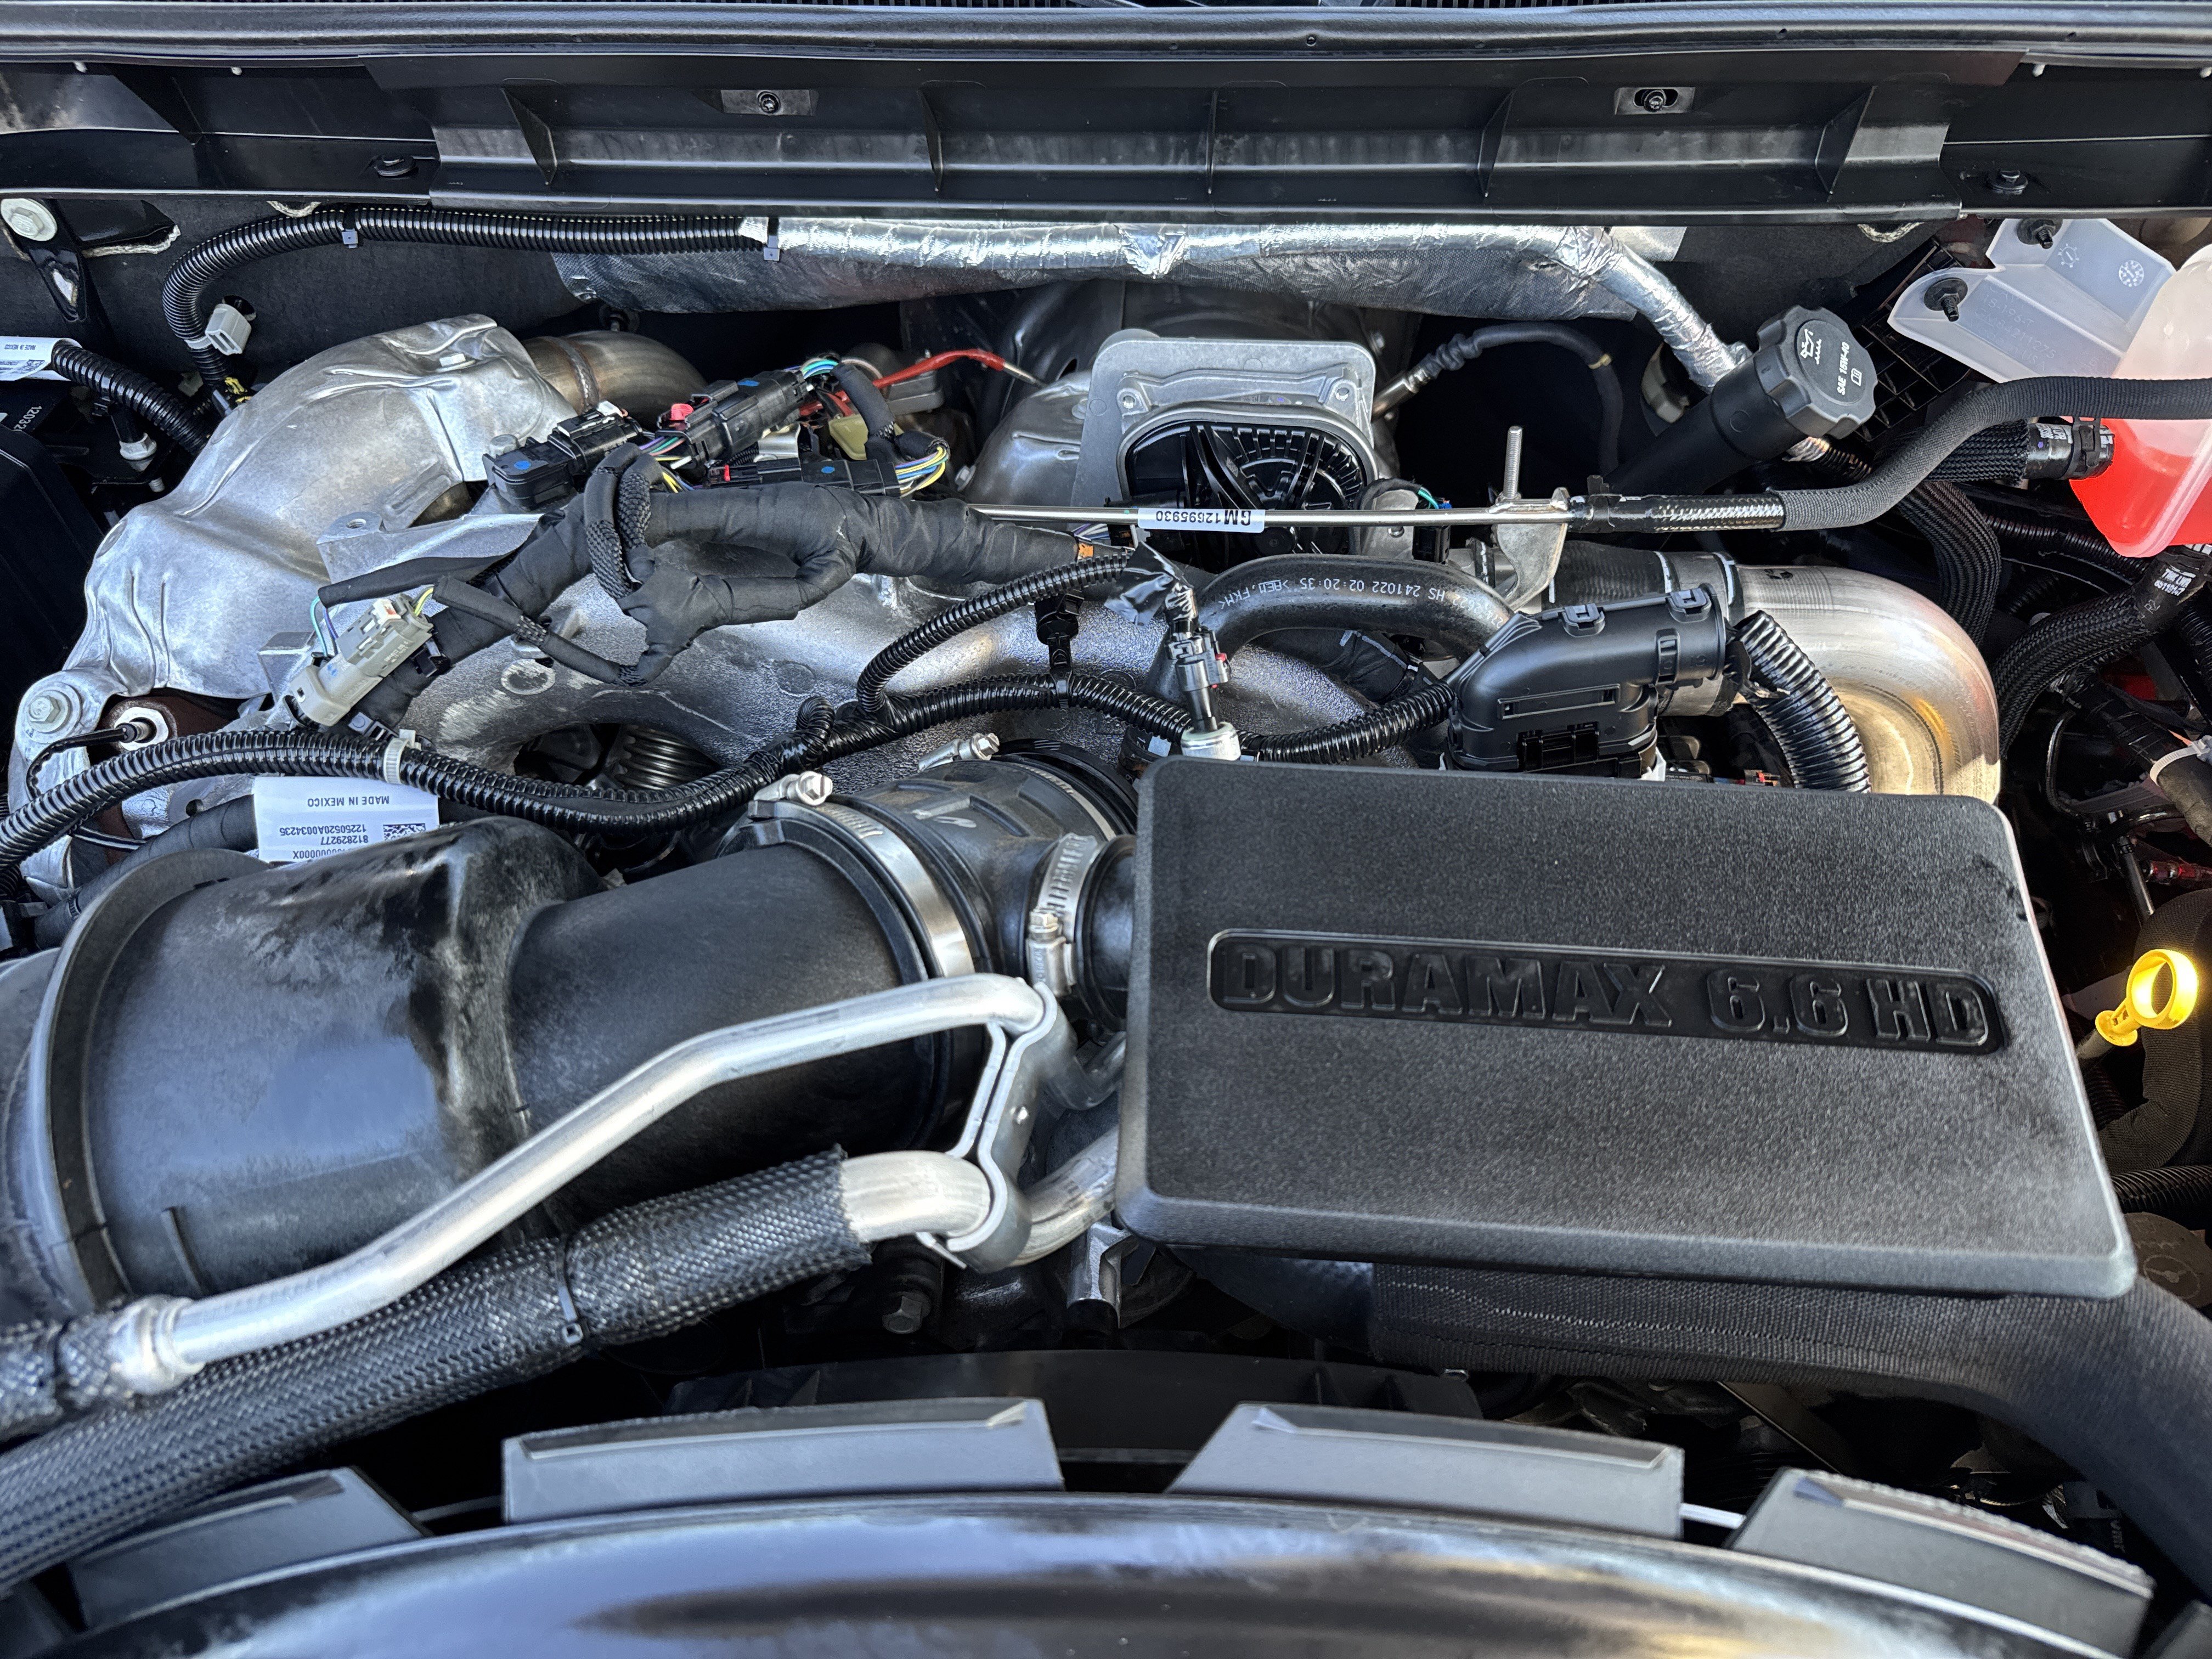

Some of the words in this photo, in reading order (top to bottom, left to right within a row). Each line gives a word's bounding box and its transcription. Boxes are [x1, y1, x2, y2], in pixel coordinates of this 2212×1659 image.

[1839, 341, 1850, 375] 15W-40
[1837, 375, 1847, 396] SAE
[12, 405, 42, 432] 12032
[1300, 578, 1365, 592] 02:20:35
[1372, 581, 1421, 597] 241022
[1427, 588, 1446, 602] HS
[307, 797, 345, 808] MEXICO
[348, 797, 359, 806] IN
[362, 795, 390, 805] MADE
[279, 823, 368, 837] 12250520A0034235
[320, 834, 369, 846] 812829277
[1222, 945, 1673, 1028] DURAMAX
[1706, 968, 1849, 1037] 6.6
[1866, 978, 1989, 1046] HD
